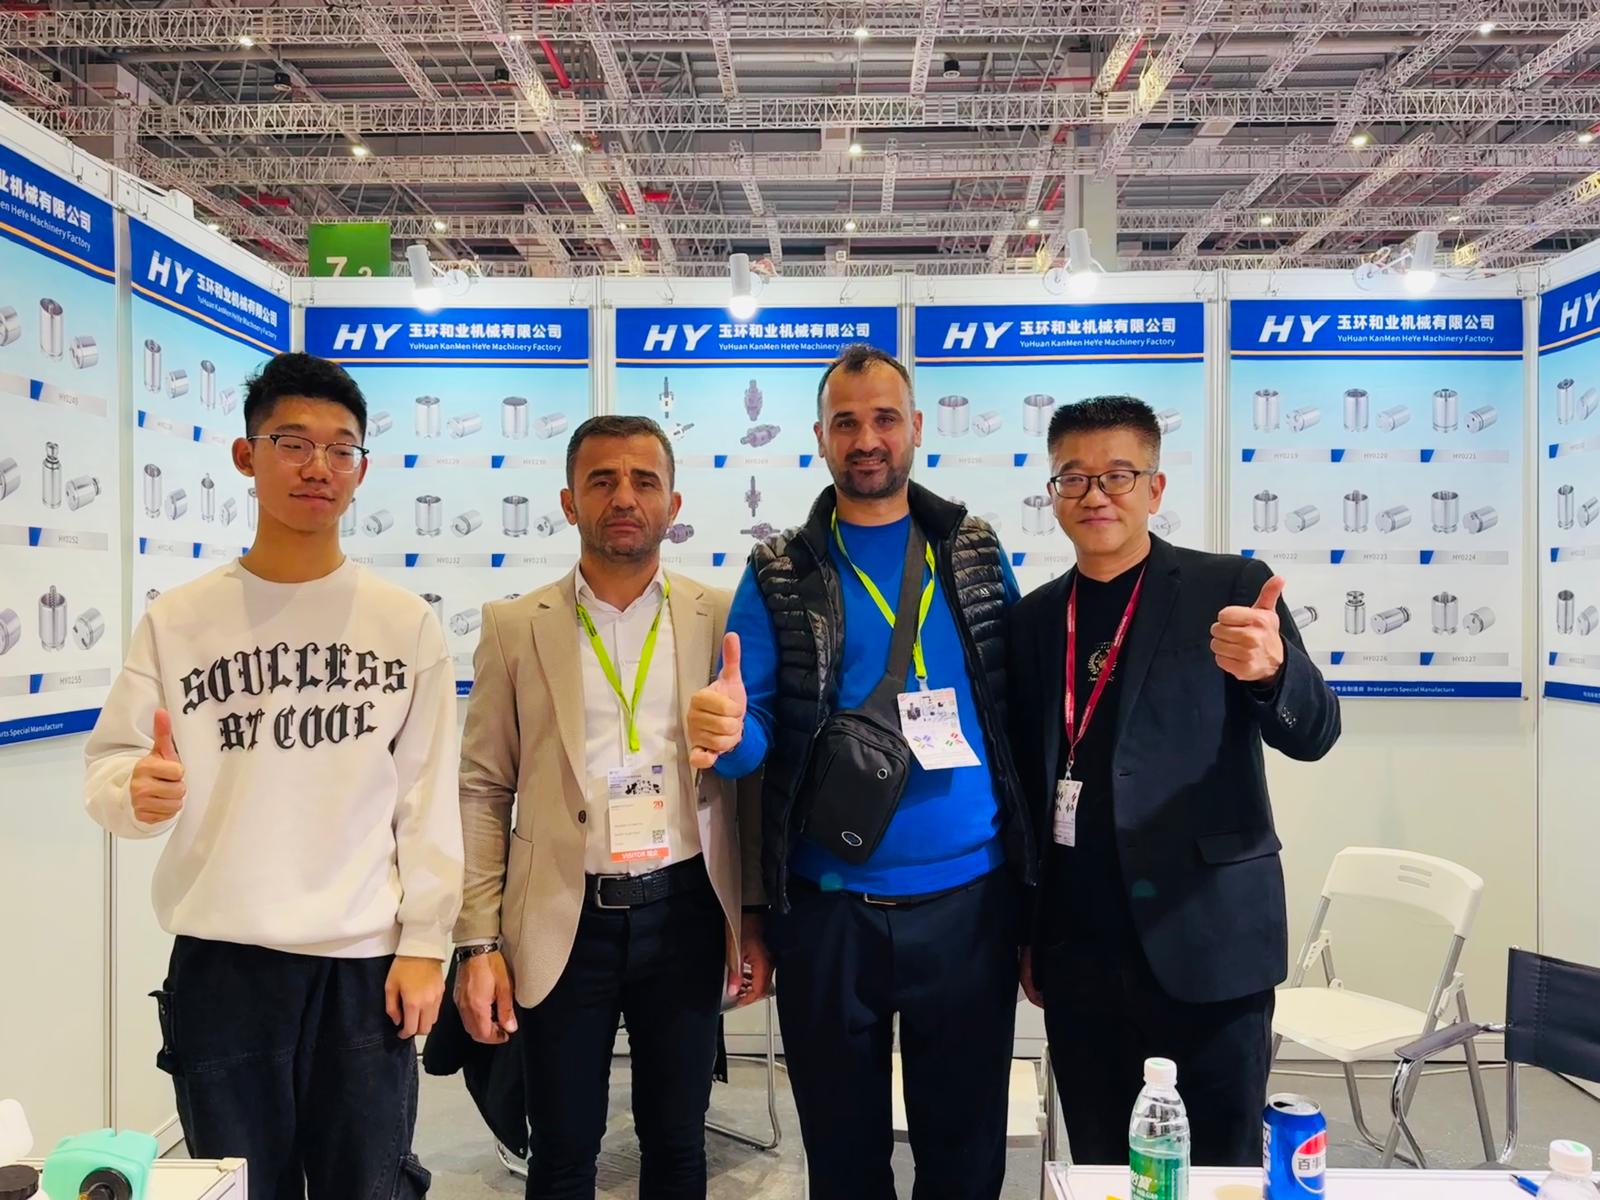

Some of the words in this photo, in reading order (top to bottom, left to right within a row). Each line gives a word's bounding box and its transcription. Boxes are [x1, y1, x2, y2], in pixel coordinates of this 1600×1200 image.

[30, 213, 67, 240] Machinery
[67, 231, 91, 252] Factory
[147, 250, 194, 295] HY
[197, 272, 278, 328] 玉环和业机械有限公司
[1558, 289, 1600, 333] HY
[718, 323, 870, 339] 玉环和业机械有限公司
[1020, 317, 1176, 336] 玉环和业机械有限公司
[1258, 315, 1332, 343] HY
[1337, 314, 1495, 331] 玉环和业机械有限公司
[333, 323, 403, 351] HY
[408, 323, 562, 340] 玉环和业机械有限公司
[643, 324, 713, 352] HY
[942, 322, 1015, 350] HY
[1337, 335, 1368, 343] YuHuan
[1369, 335, 1401, 343] KanMen
[1402, 335, 1422, 343] HeYe
[1422, 335, 1463, 344] Machinery
[1464, 334, 1494, 344] Factory
[409, 342, 439, 351] YuHuan
[440, 342, 471, 351] KanMen
[472, 343, 491, 351] HeYe
[492, 343, 532, 353] Machinery
[532, 343, 562, 353] Factory
[718, 343, 748, 351] YuHuan
[749, 343, 780, 351] KanMen
[781, 343, 800, 351] HeYe
[800, 343, 840, 352] Machinery
[1020, 340, 1050, 348] YuHuan
[1051, 340, 1083, 348] KanMen
[1083, 338, 1103, 347] HeYe
[1104, 338, 1145, 347] Machinery
[1146, 337, 1176, 347] Factory
[1273, 552, 1298, 560] HY0222
[1363, 552, 1388, 561] HY0223
[1452, 552, 1477, 561] HY0224
[1452, 655, 1477, 663] HY0227
[180, 642, 407, 715] SOULLESS
[1399, 686, 1420, 694] Special
[10, 727, 30, 737] Special
[31, 722, 64, 733] Manufacture
[274, 701, 378, 749] COOL
